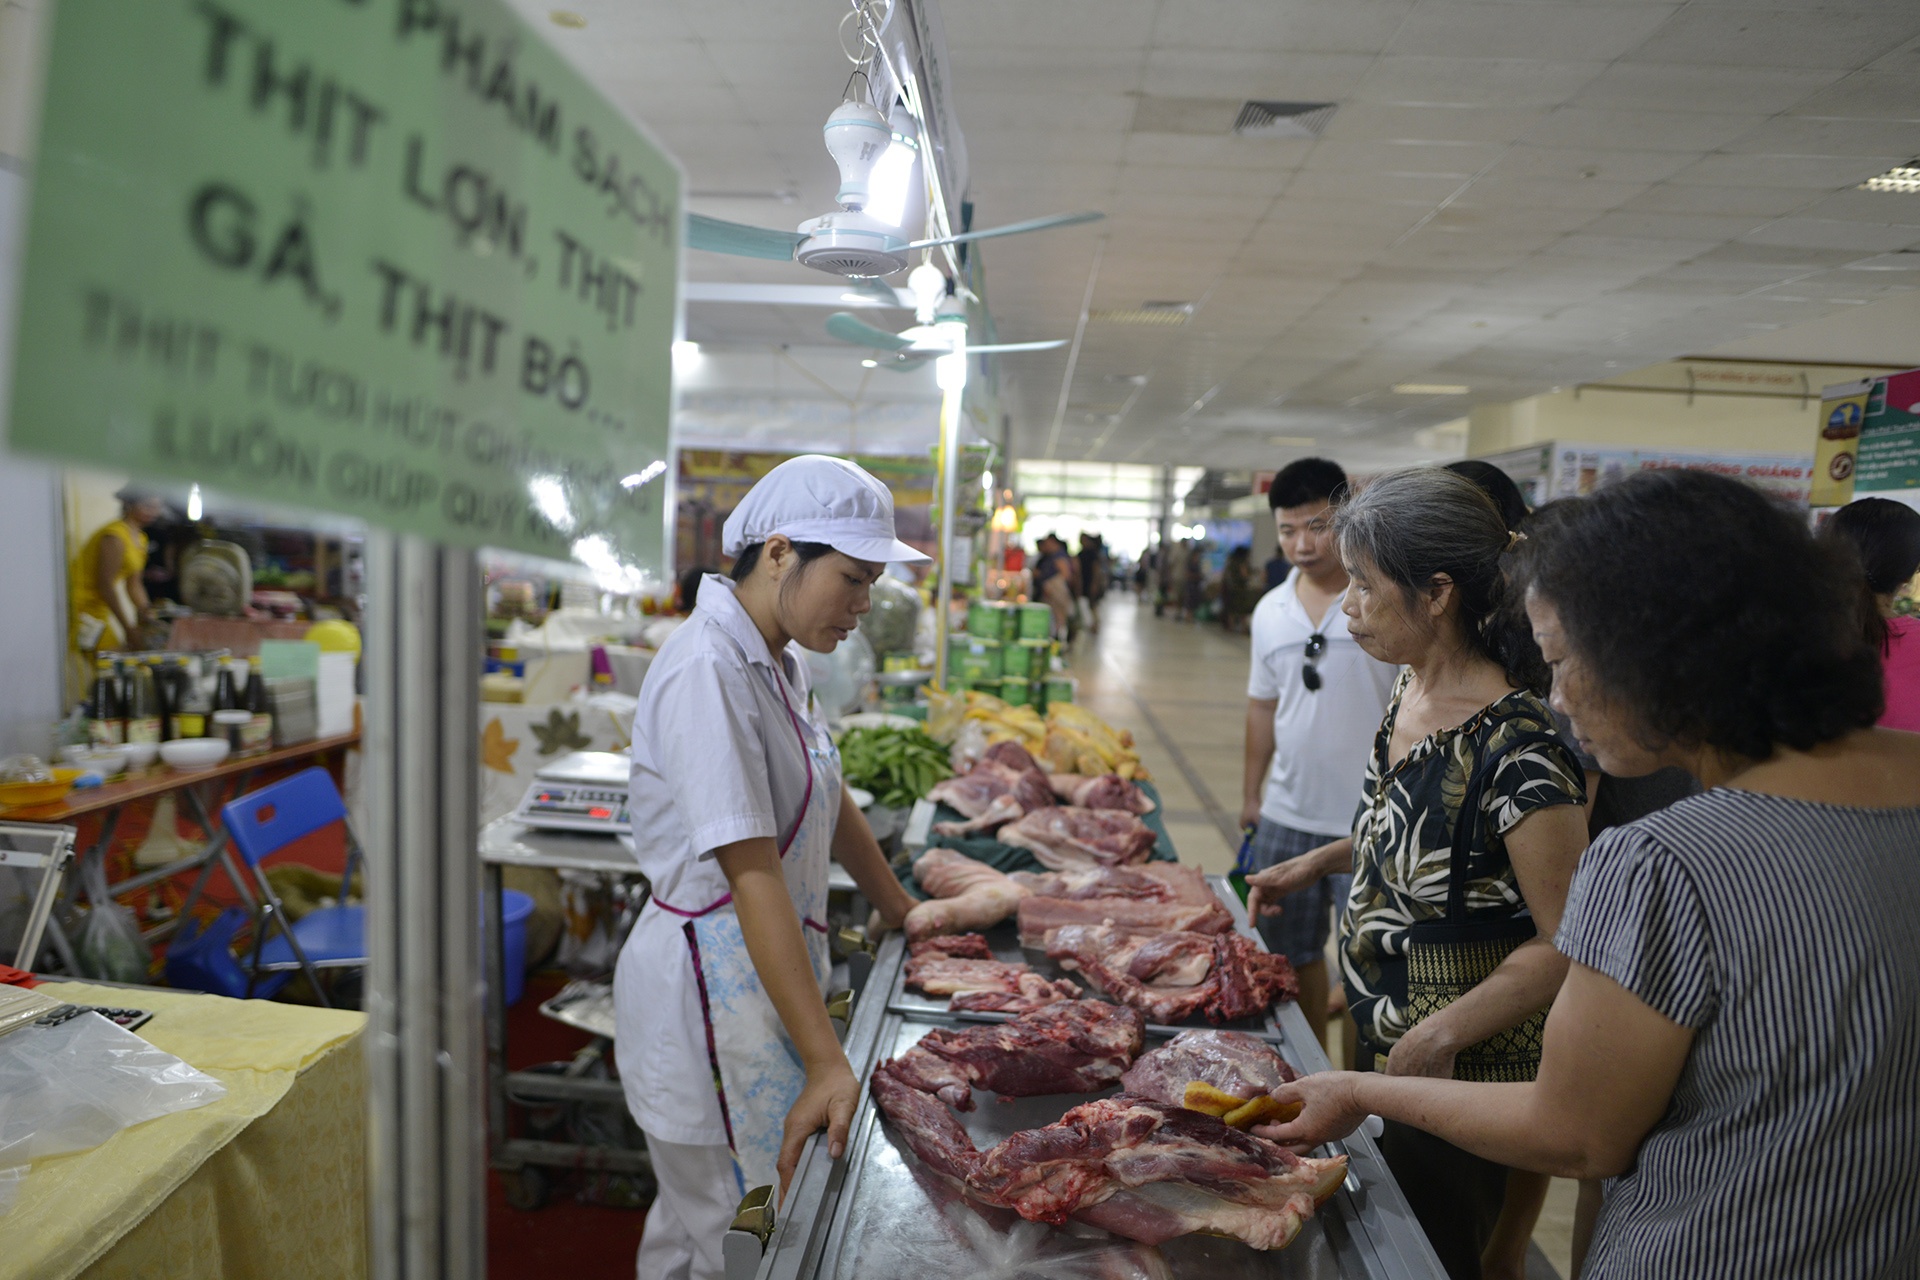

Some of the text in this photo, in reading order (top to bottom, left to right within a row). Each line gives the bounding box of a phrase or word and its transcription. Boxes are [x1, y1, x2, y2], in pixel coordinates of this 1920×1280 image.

[192, 0, 386, 172] THỊT
[554, 228, 642, 332] THỊT
[371, 255, 508, 383] THỊT
